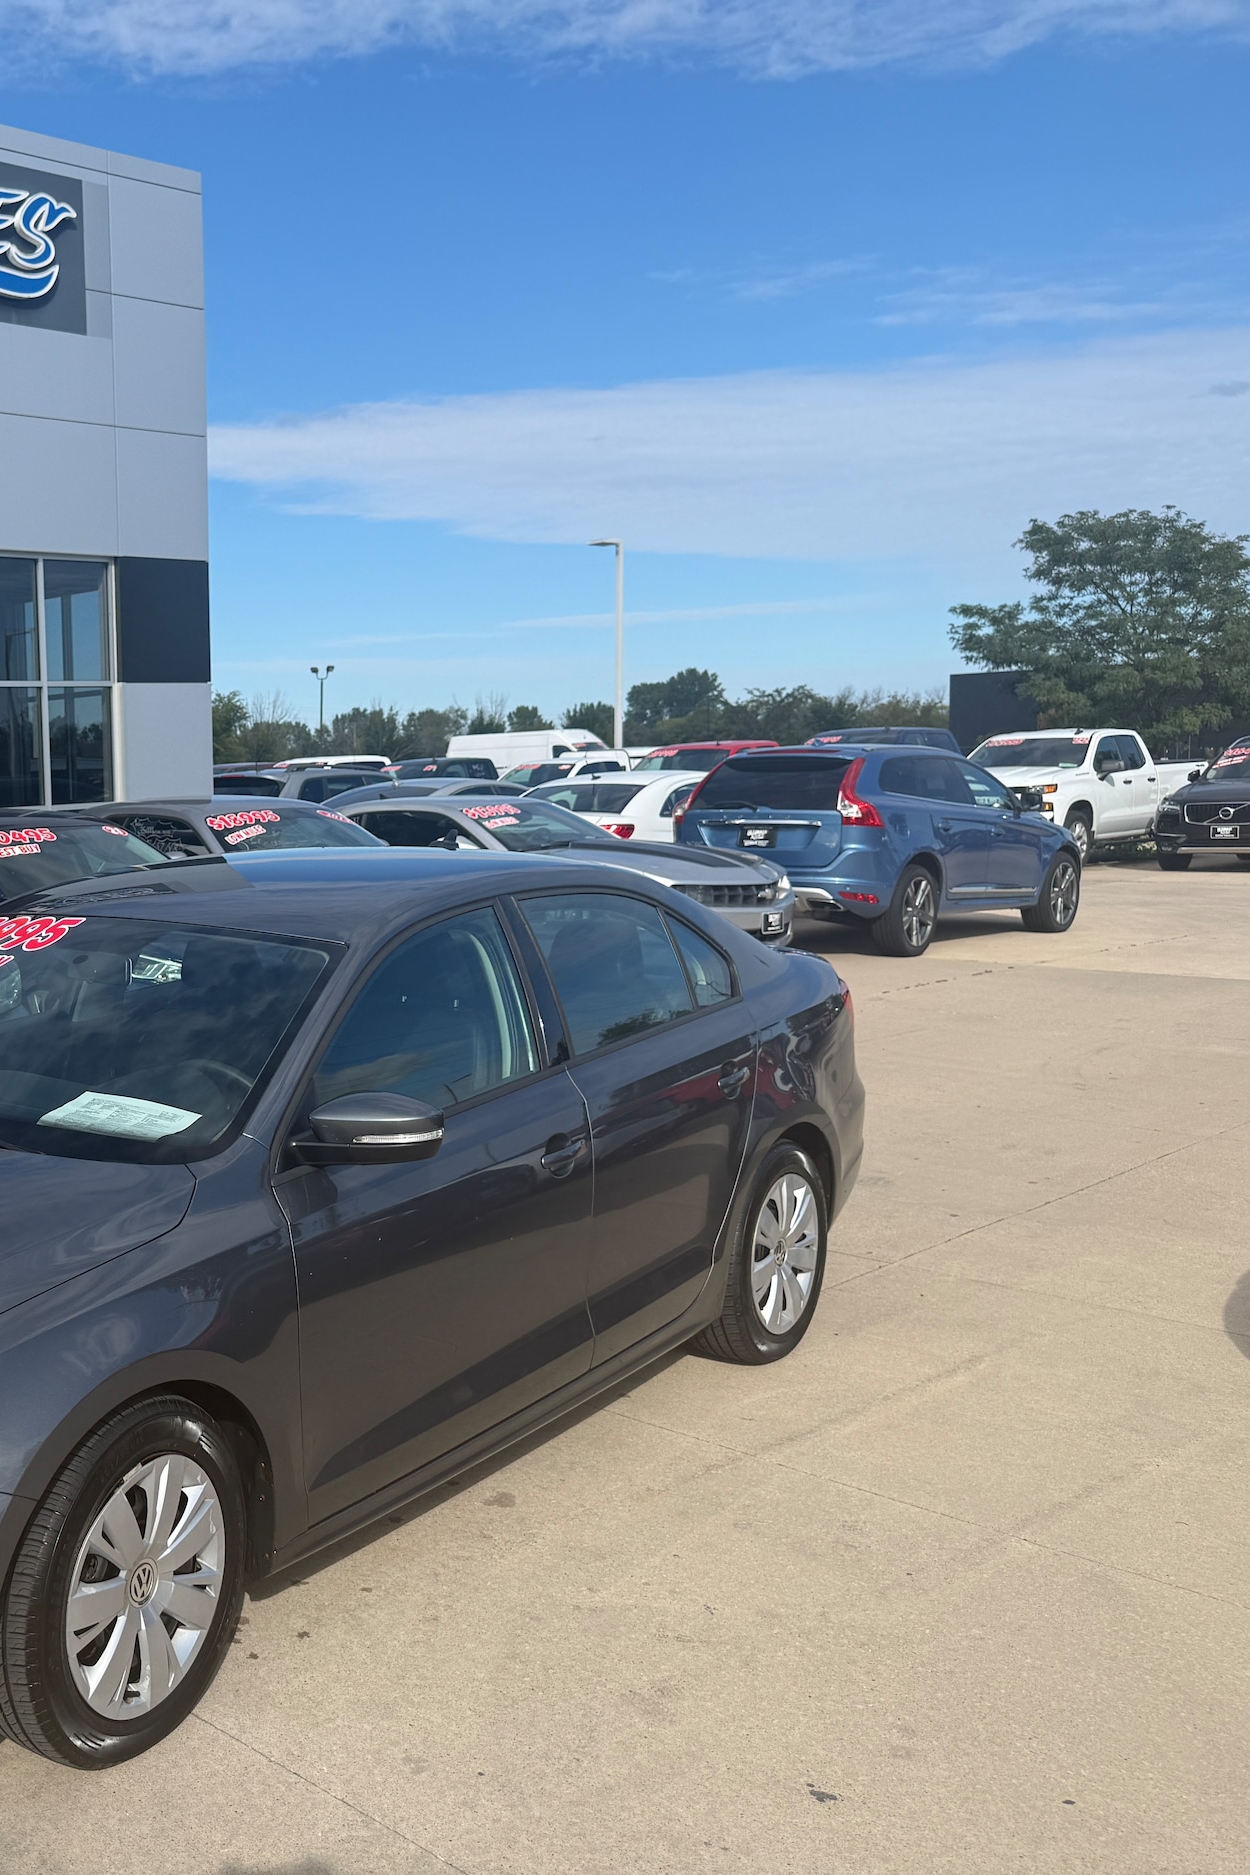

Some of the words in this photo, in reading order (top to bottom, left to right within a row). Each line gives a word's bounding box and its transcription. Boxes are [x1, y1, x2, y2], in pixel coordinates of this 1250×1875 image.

[206, 810, 280, 830] $18995
[225, 830, 244, 845] LOW
[244, 825, 266, 838] MILES
[19, 843, 41, 855] BUY
